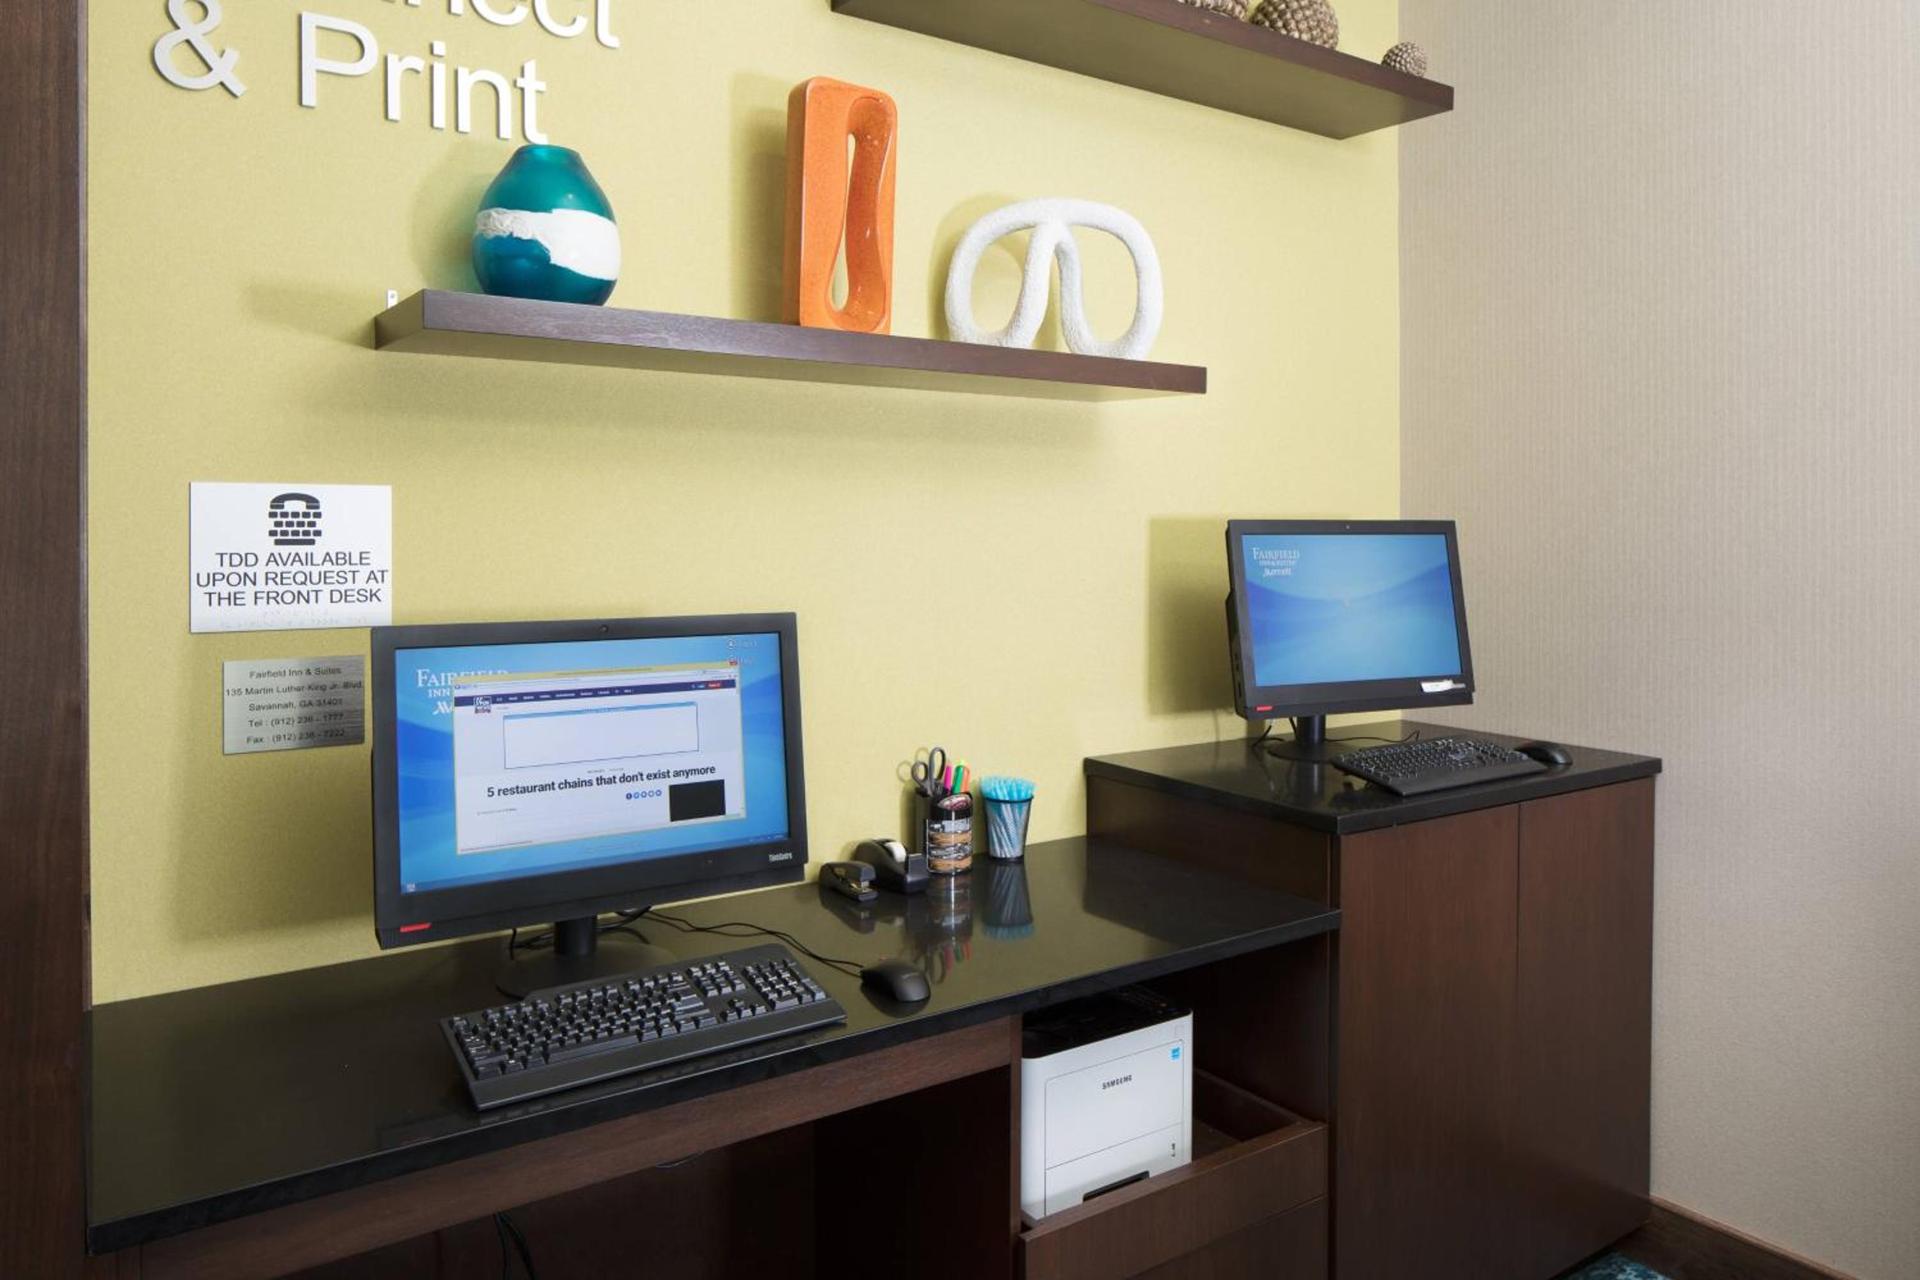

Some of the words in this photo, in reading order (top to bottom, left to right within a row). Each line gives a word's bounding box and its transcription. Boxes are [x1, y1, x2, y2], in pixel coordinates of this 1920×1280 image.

[153, 0, 247, 98] &
[299, 11, 550, 145] Print
[215, 552, 259, 568] TDD
[265, 551, 372, 567] AVAILABLE
[196, 571, 257, 588] UPON
[264, 569, 361, 587] REQUEST
[366, 569, 389, 585] AT
[203, 590, 246, 607] THE
[253, 589, 323, 606] FRONT
[329, 588, 382, 604] DESK
[288, 668, 303, 677] Inn
[487, 786, 495, 798] 5
[497, 781, 556, 797] restaurant
[558, 777, 593, 791] chains
[595, 775, 617, 787] that
[619, 771, 644, 784] don't
[646, 769, 671, 781] exist
[672, 765, 716, 779] anymore
